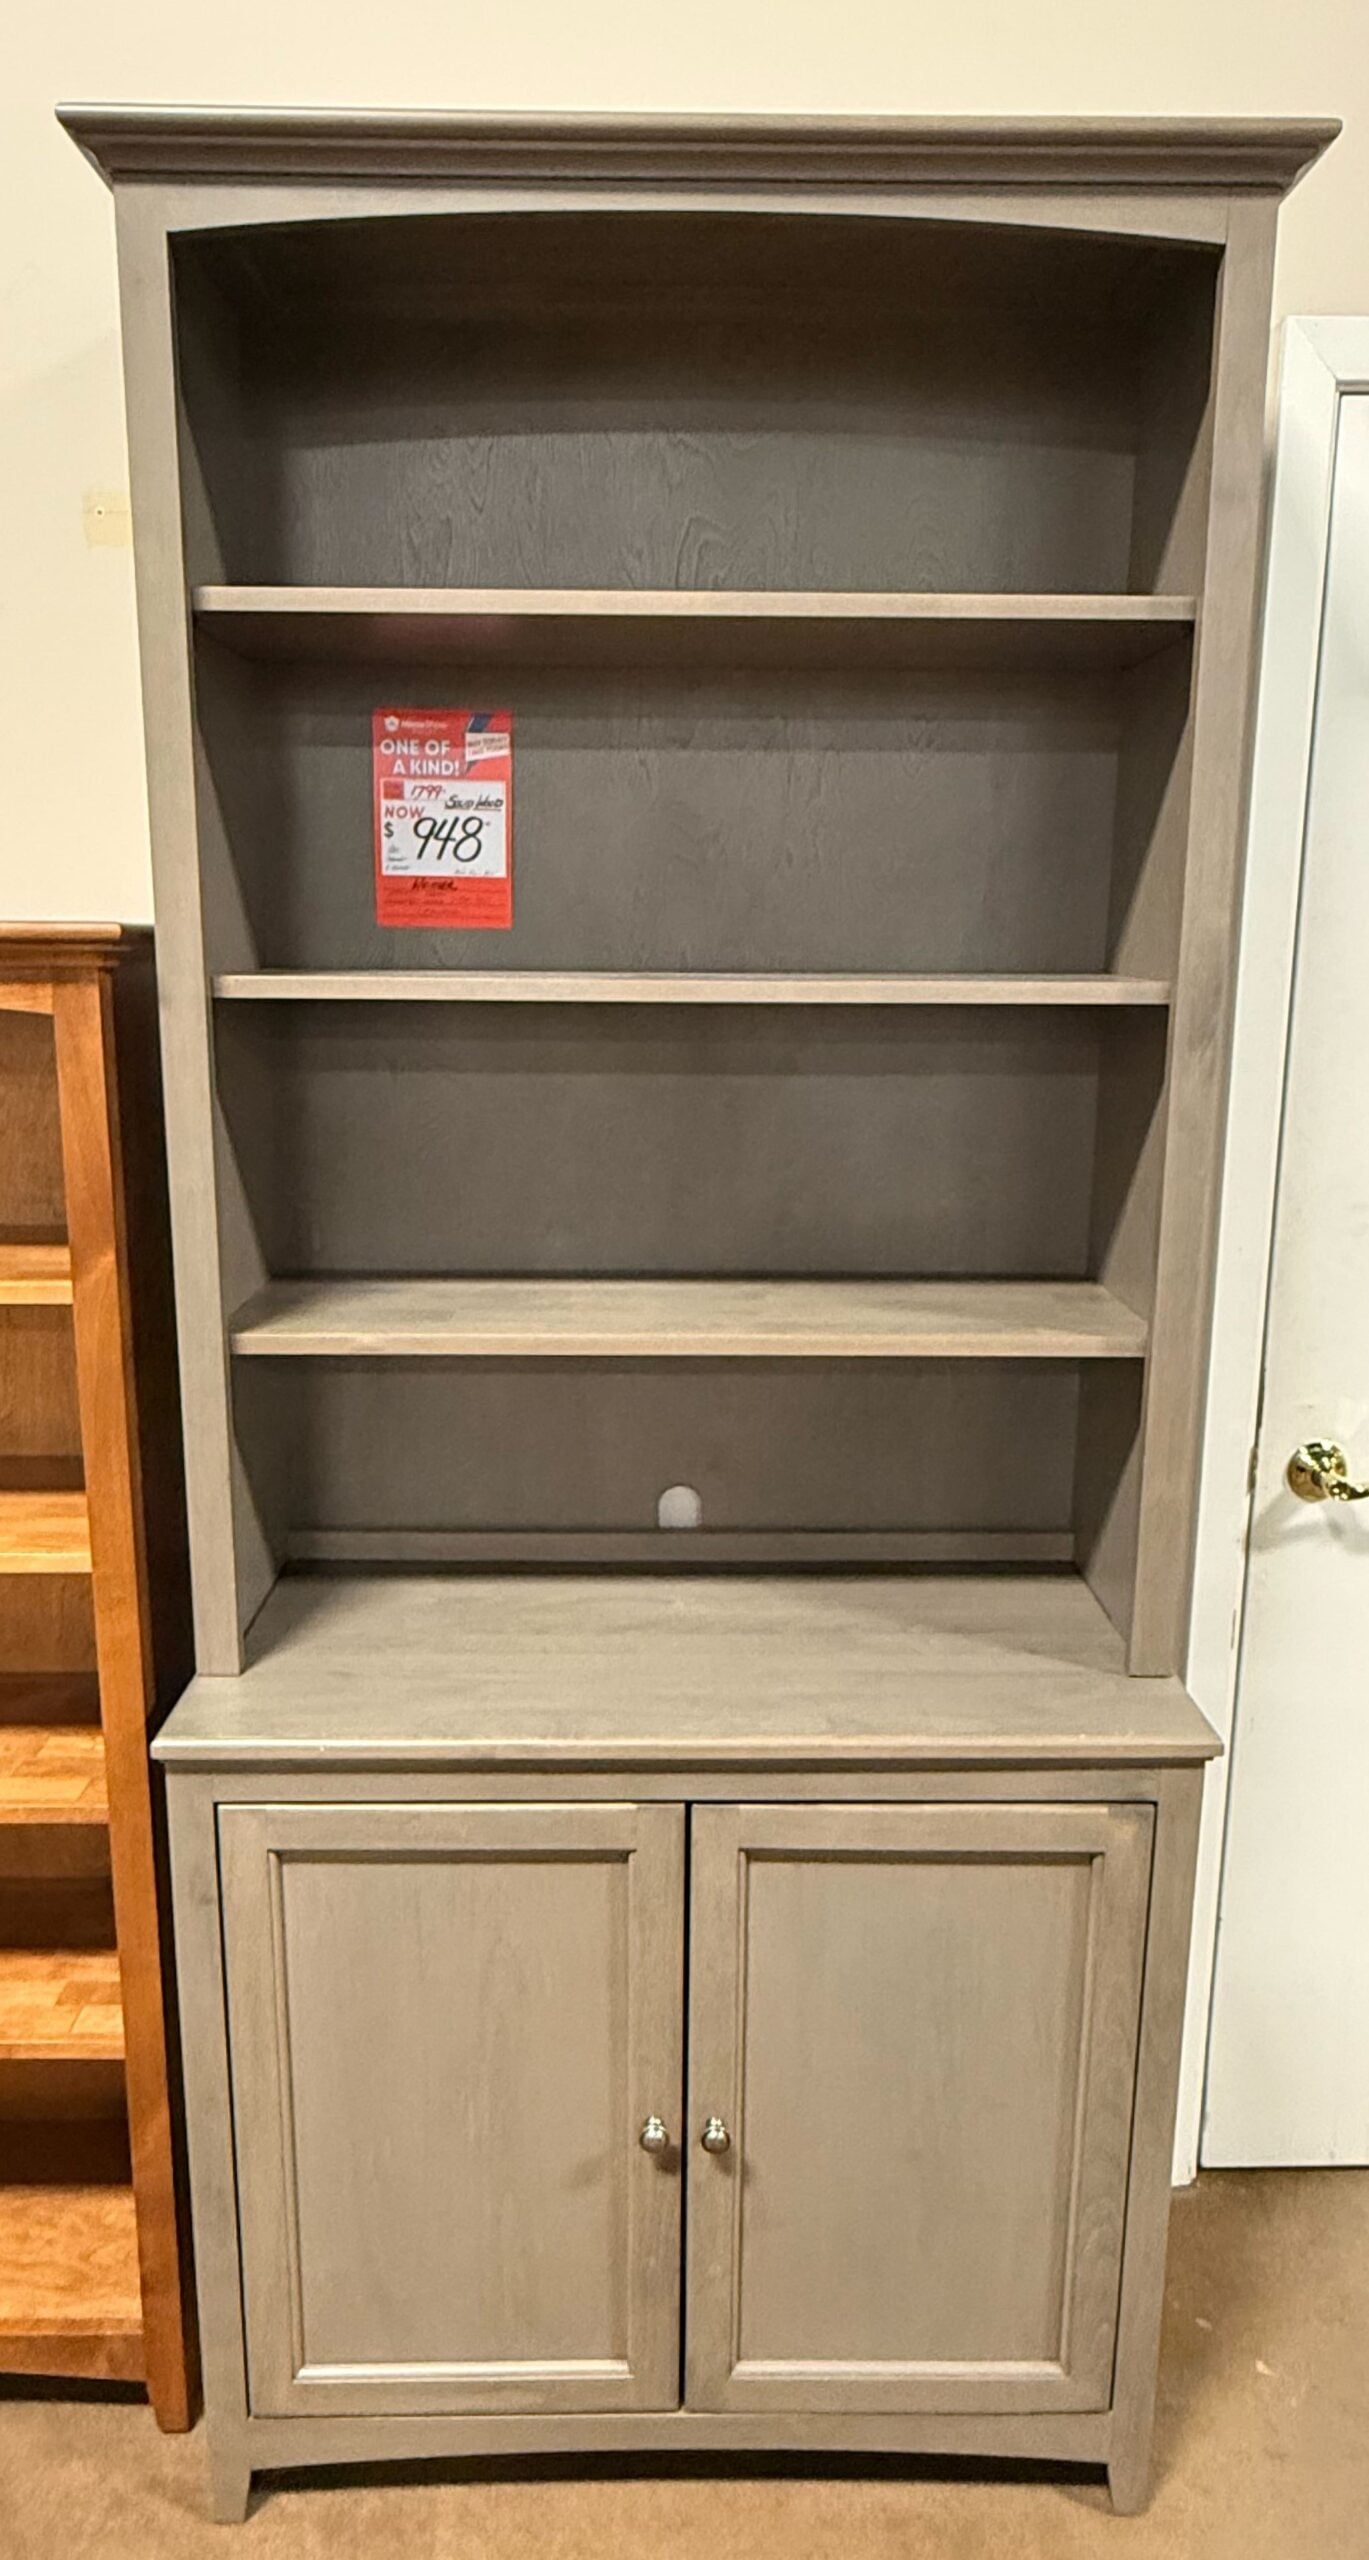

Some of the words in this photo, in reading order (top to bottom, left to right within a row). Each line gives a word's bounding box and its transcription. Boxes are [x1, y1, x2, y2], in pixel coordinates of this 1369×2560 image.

[380, 739, 420, 755] ONE
[425, 739, 451, 755] OF
[392, 760, 406, 775] A
[410, 760, 460, 776] KIND!
[384, 805, 425, 819] NOW
[413, 815, 484, 863] 948
